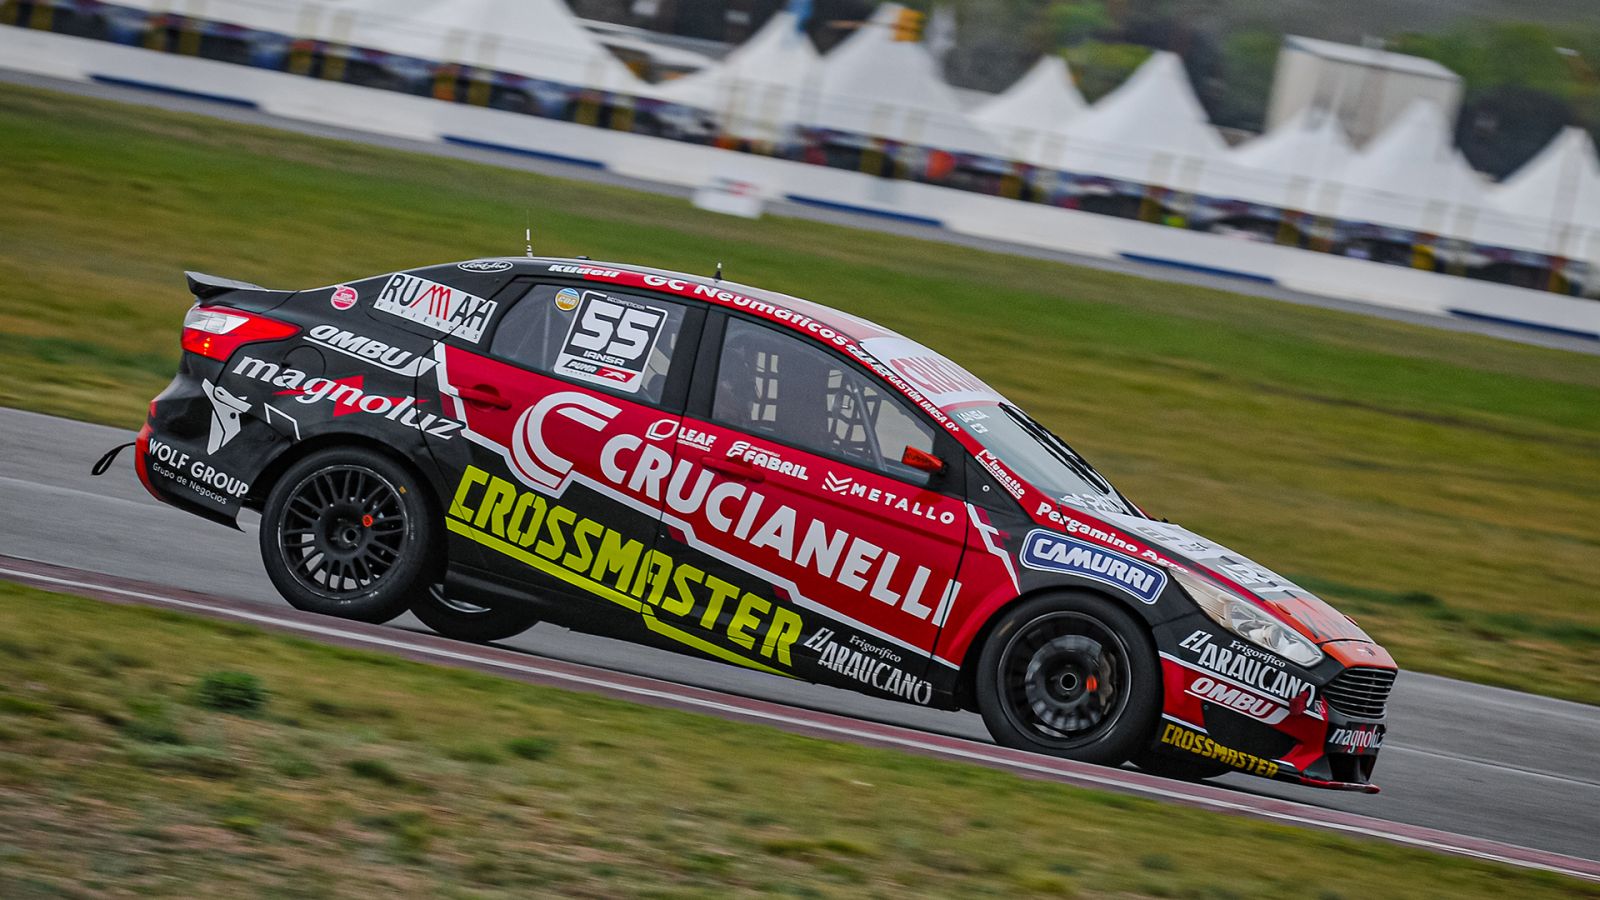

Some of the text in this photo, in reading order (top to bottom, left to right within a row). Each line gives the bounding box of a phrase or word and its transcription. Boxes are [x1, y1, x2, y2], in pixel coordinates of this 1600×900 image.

[382, 274, 493, 331] RUMAH
[570, 299, 660, 361] 55
[643, 275, 849, 346] GC Neumáticos
[309, 325, 412, 367] OMBU
[567, 361, 598, 373] PUMA
[583, 350, 625, 366] IANSA
[232, 356, 464, 440] magnoluz
[919, 398, 947, 424] IANSA
[149, 438, 249, 498] WOLF GROUP
[152, 462, 227, 505] Grupo de Negocios
[743, 450, 809, 480] FABRIL
[600, 433, 962, 628] CRUCIANELLI
[850, 482, 956, 525] METALLO
[1035, 501, 1138, 554] Pergamino
[448, 464, 803, 667] CROSSMASTER
[1033, 537, 1156, 594] CAMURRI
[818, 640, 932, 705] ARAUCANO
[1190, 677, 1275, 717] OMBU
[1199, 643, 1316, 707] ARAUCANO
[1161, 722, 1280, 778] CROSSMASTER
